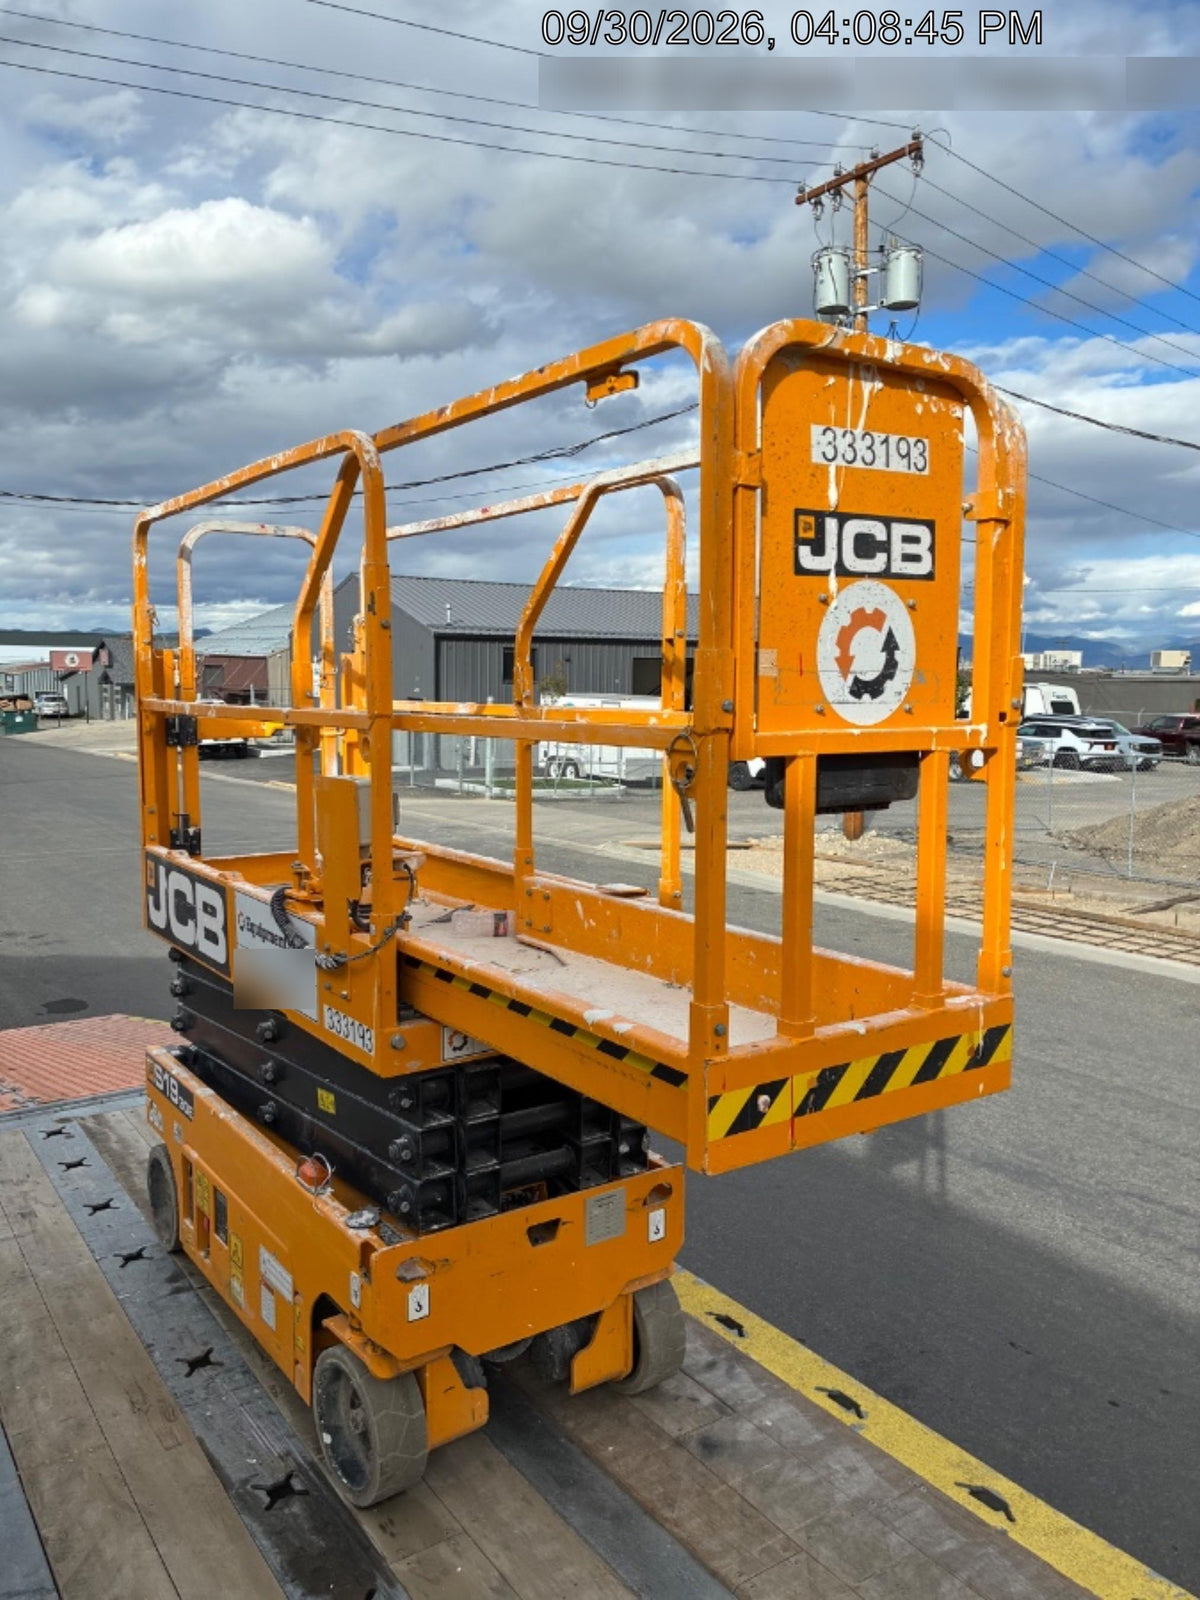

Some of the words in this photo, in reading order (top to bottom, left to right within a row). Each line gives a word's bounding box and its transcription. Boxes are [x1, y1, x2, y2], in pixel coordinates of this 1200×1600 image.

[821, 426, 927, 472] 333193
[798, 516, 933, 575] JCB
[148, 864, 227, 965] JCB
[327, 1007, 373, 1053] 333193
